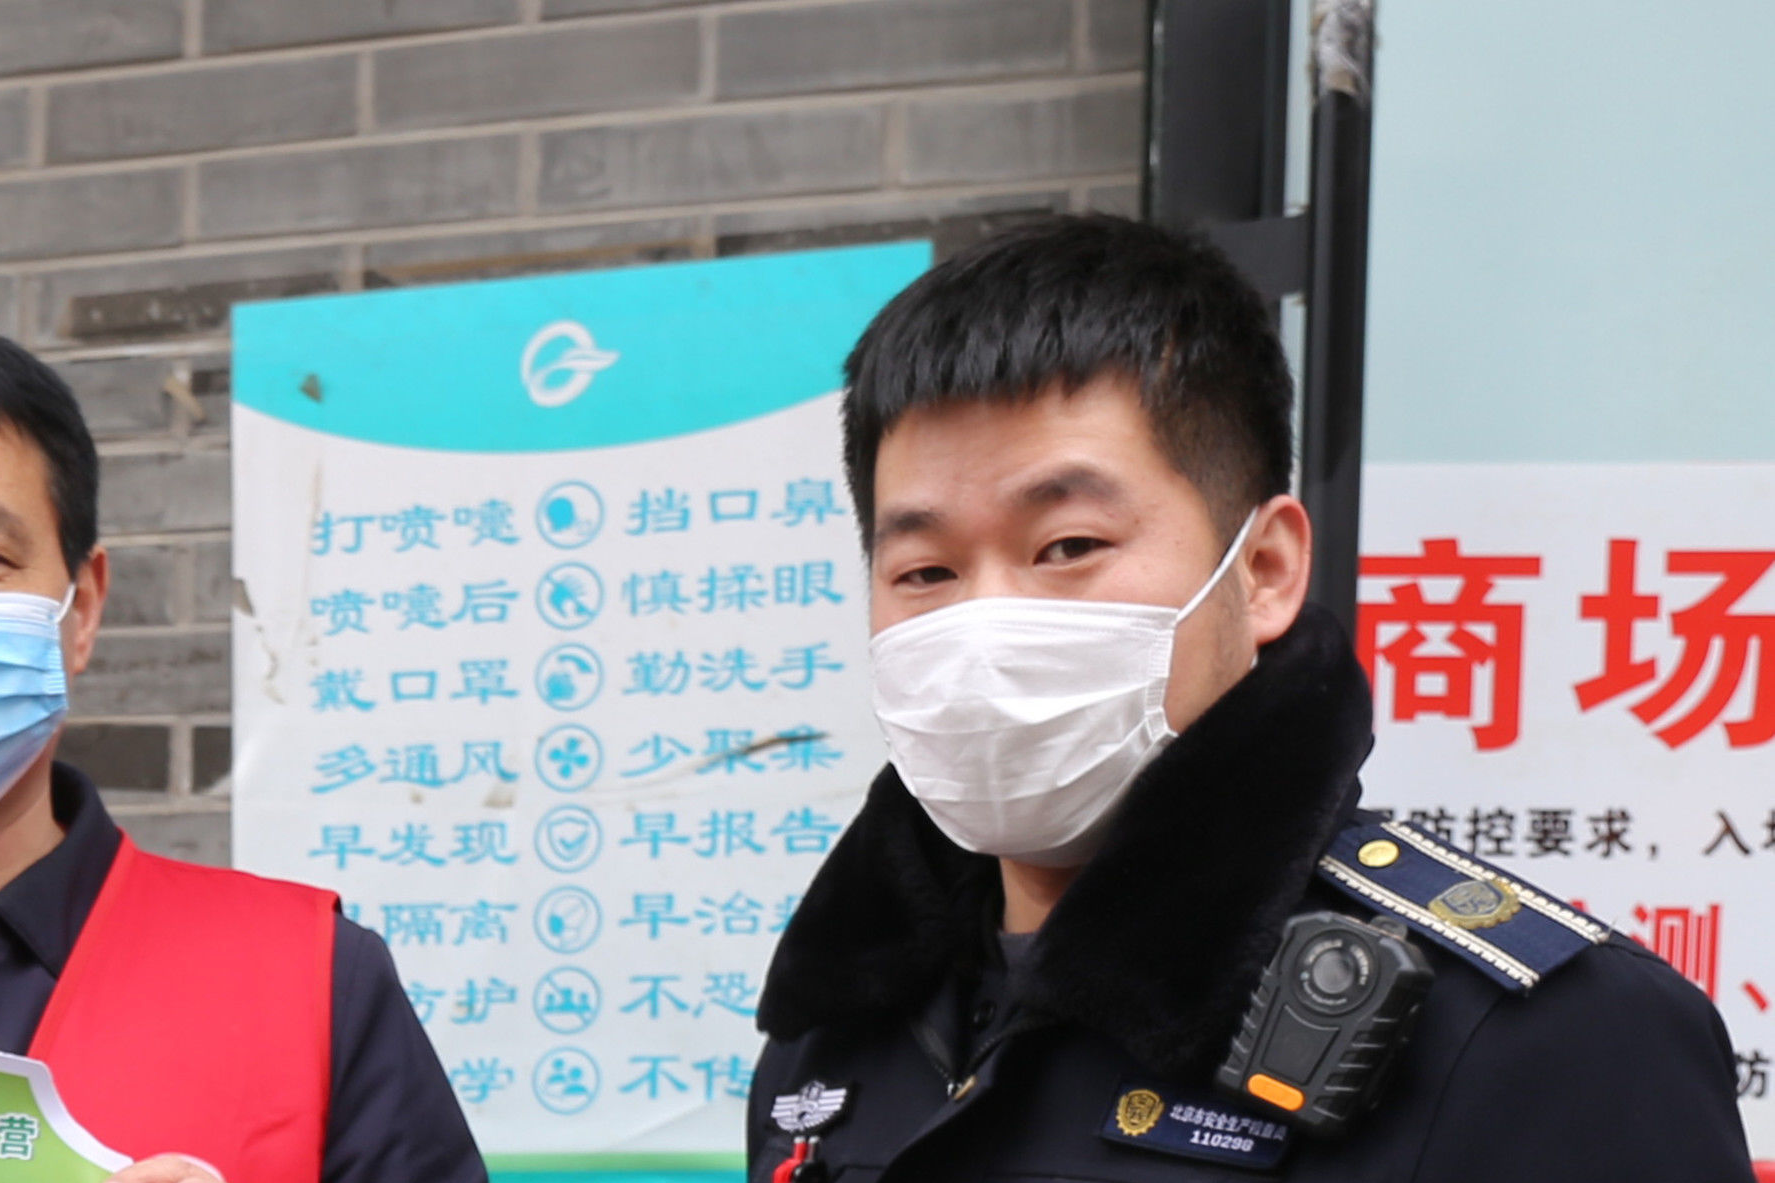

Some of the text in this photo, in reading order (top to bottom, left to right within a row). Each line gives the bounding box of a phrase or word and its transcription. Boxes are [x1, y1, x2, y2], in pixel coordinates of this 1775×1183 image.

[311, 478, 846, 555] 打喷嚏 挡口鼻
[310, 560, 845, 636] 喷嚏后 慎揉眼
[311, 641, 844, 711] 戴口罩 勤洗手
[1357, 537, 1775, 751] 商场
[310, 724, 843, 794] 多通风 少聚集
[309, 806, 841, 870] 早发现 早报告
[345, 900, 518, 945] 隔离
